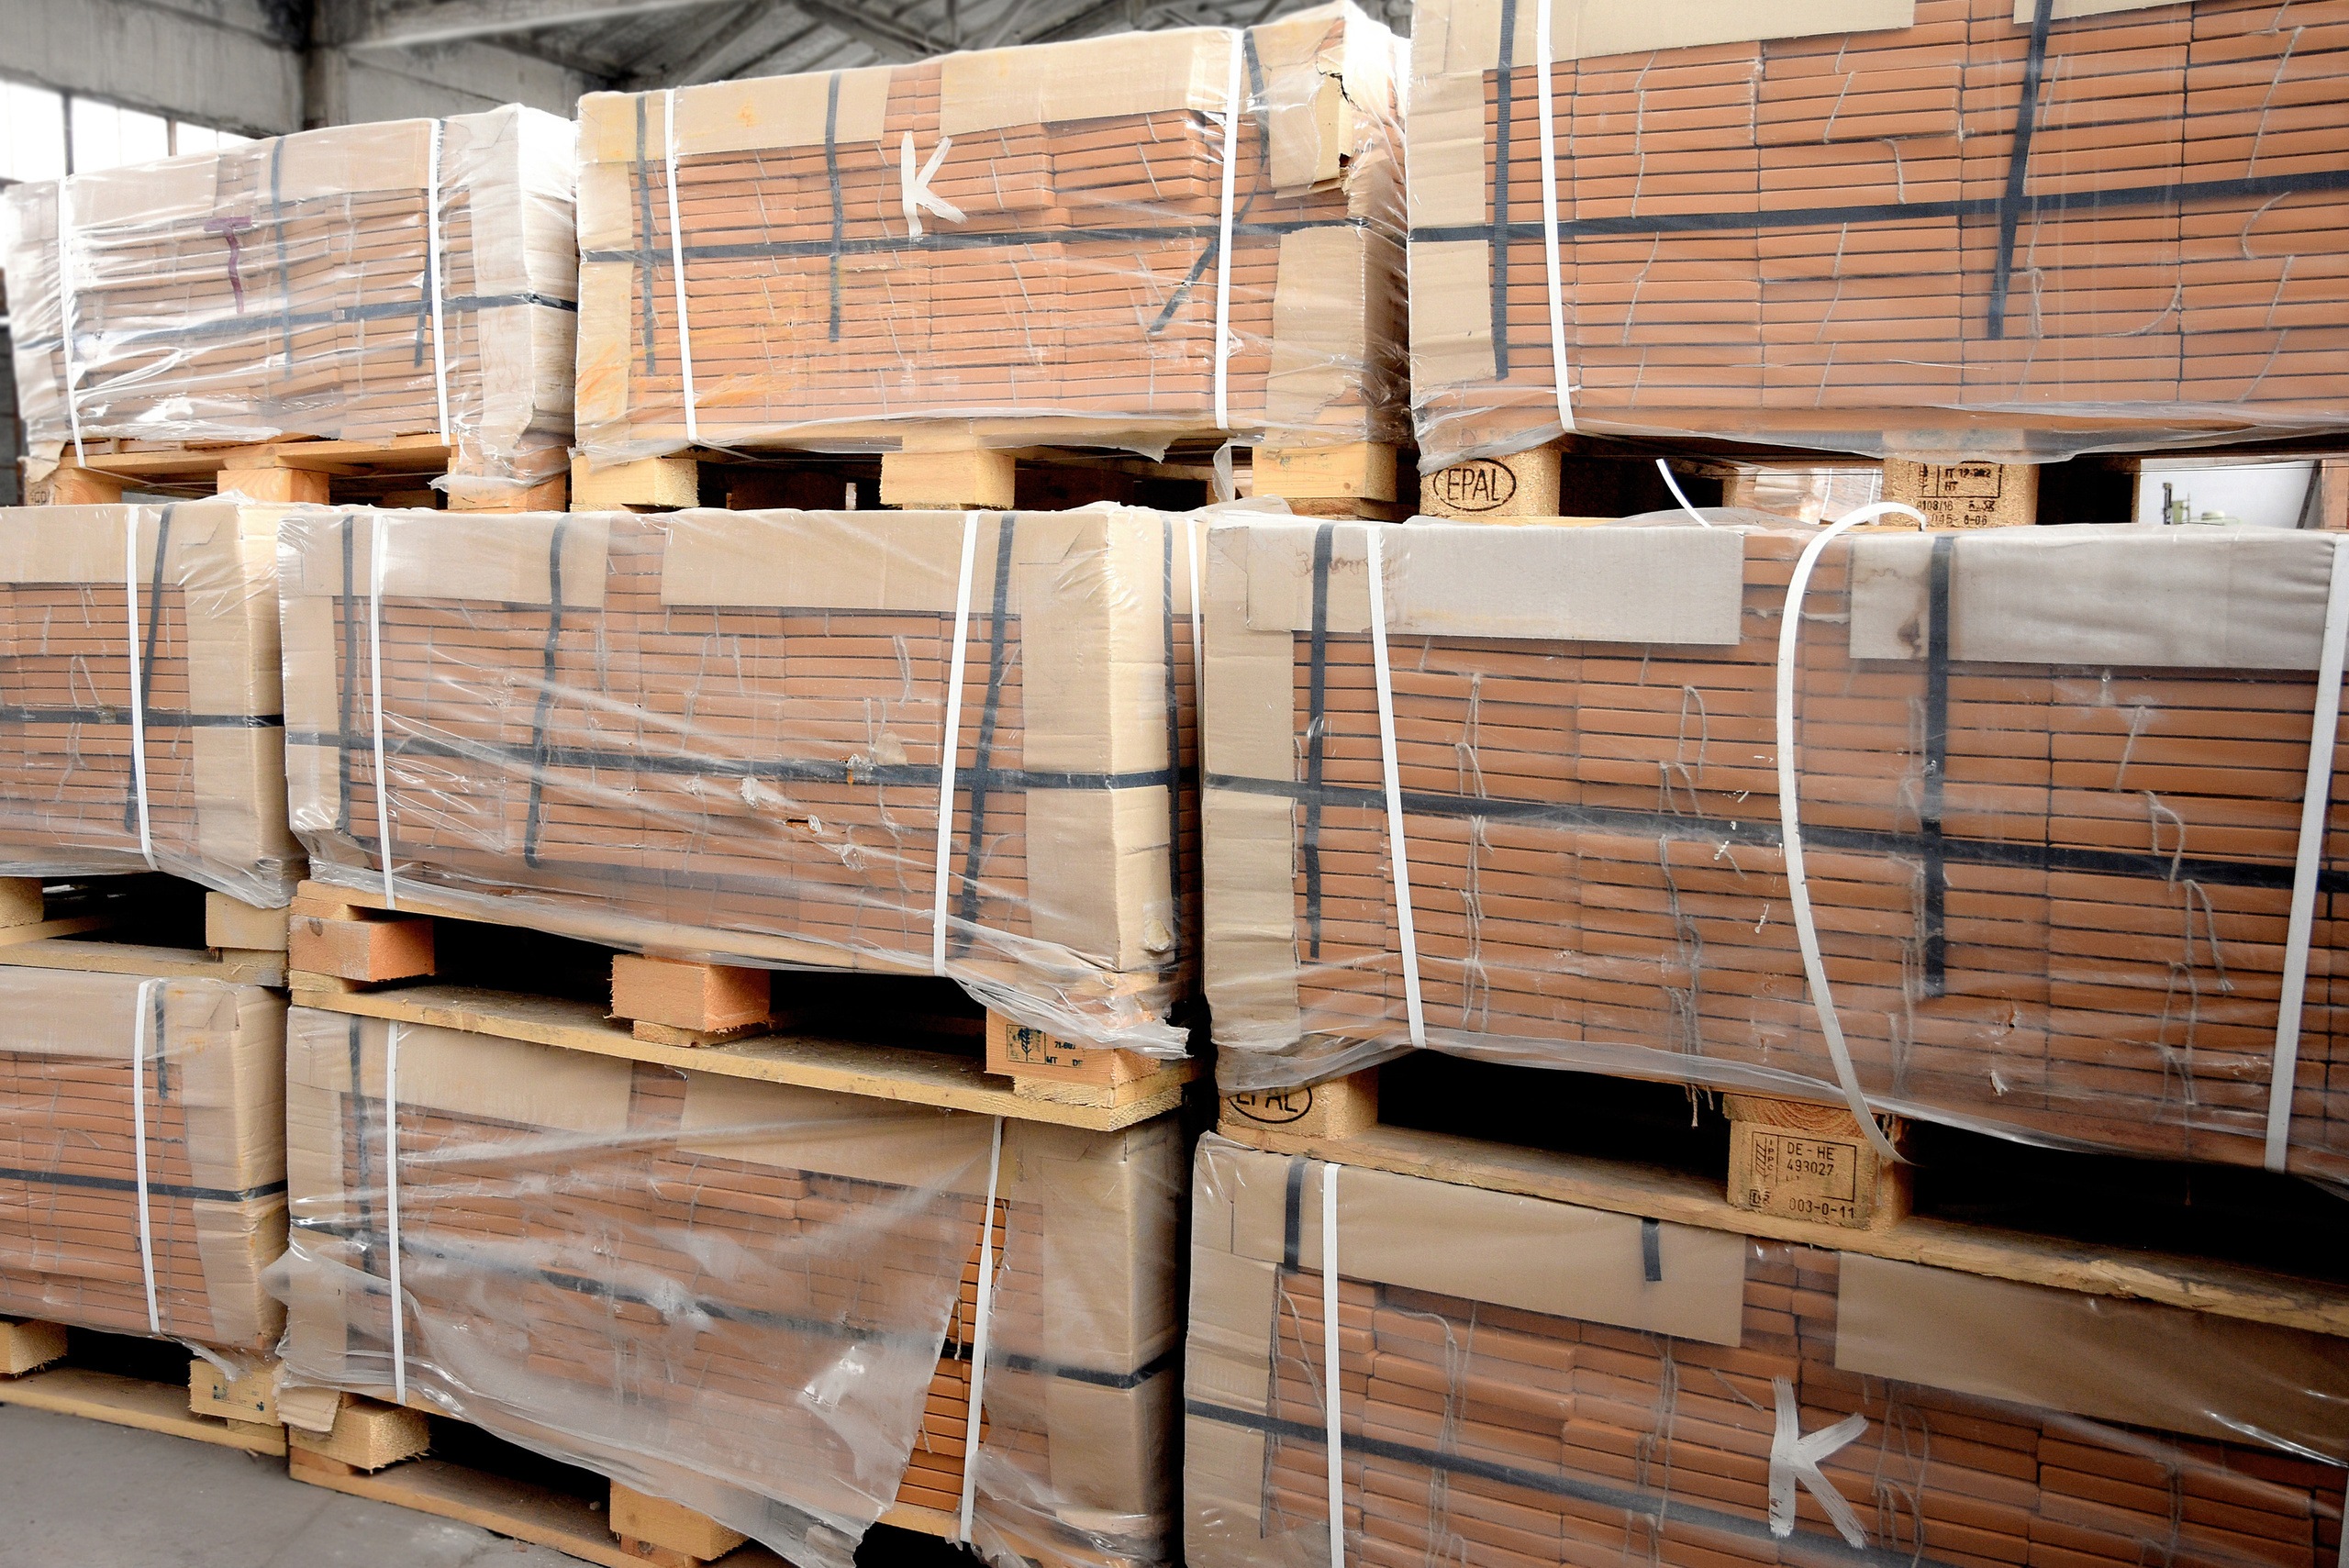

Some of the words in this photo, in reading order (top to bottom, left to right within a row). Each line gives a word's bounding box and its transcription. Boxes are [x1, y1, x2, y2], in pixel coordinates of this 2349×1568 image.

[900, 130, 968, 242] K
[1447, 468, 1501, 502] EPAL
[1787, 1158, 1834, 1177] 493027
[1789, 1197, 1854, 1219] 003-0-11
[1768, 1373, 1870, 1550] K
